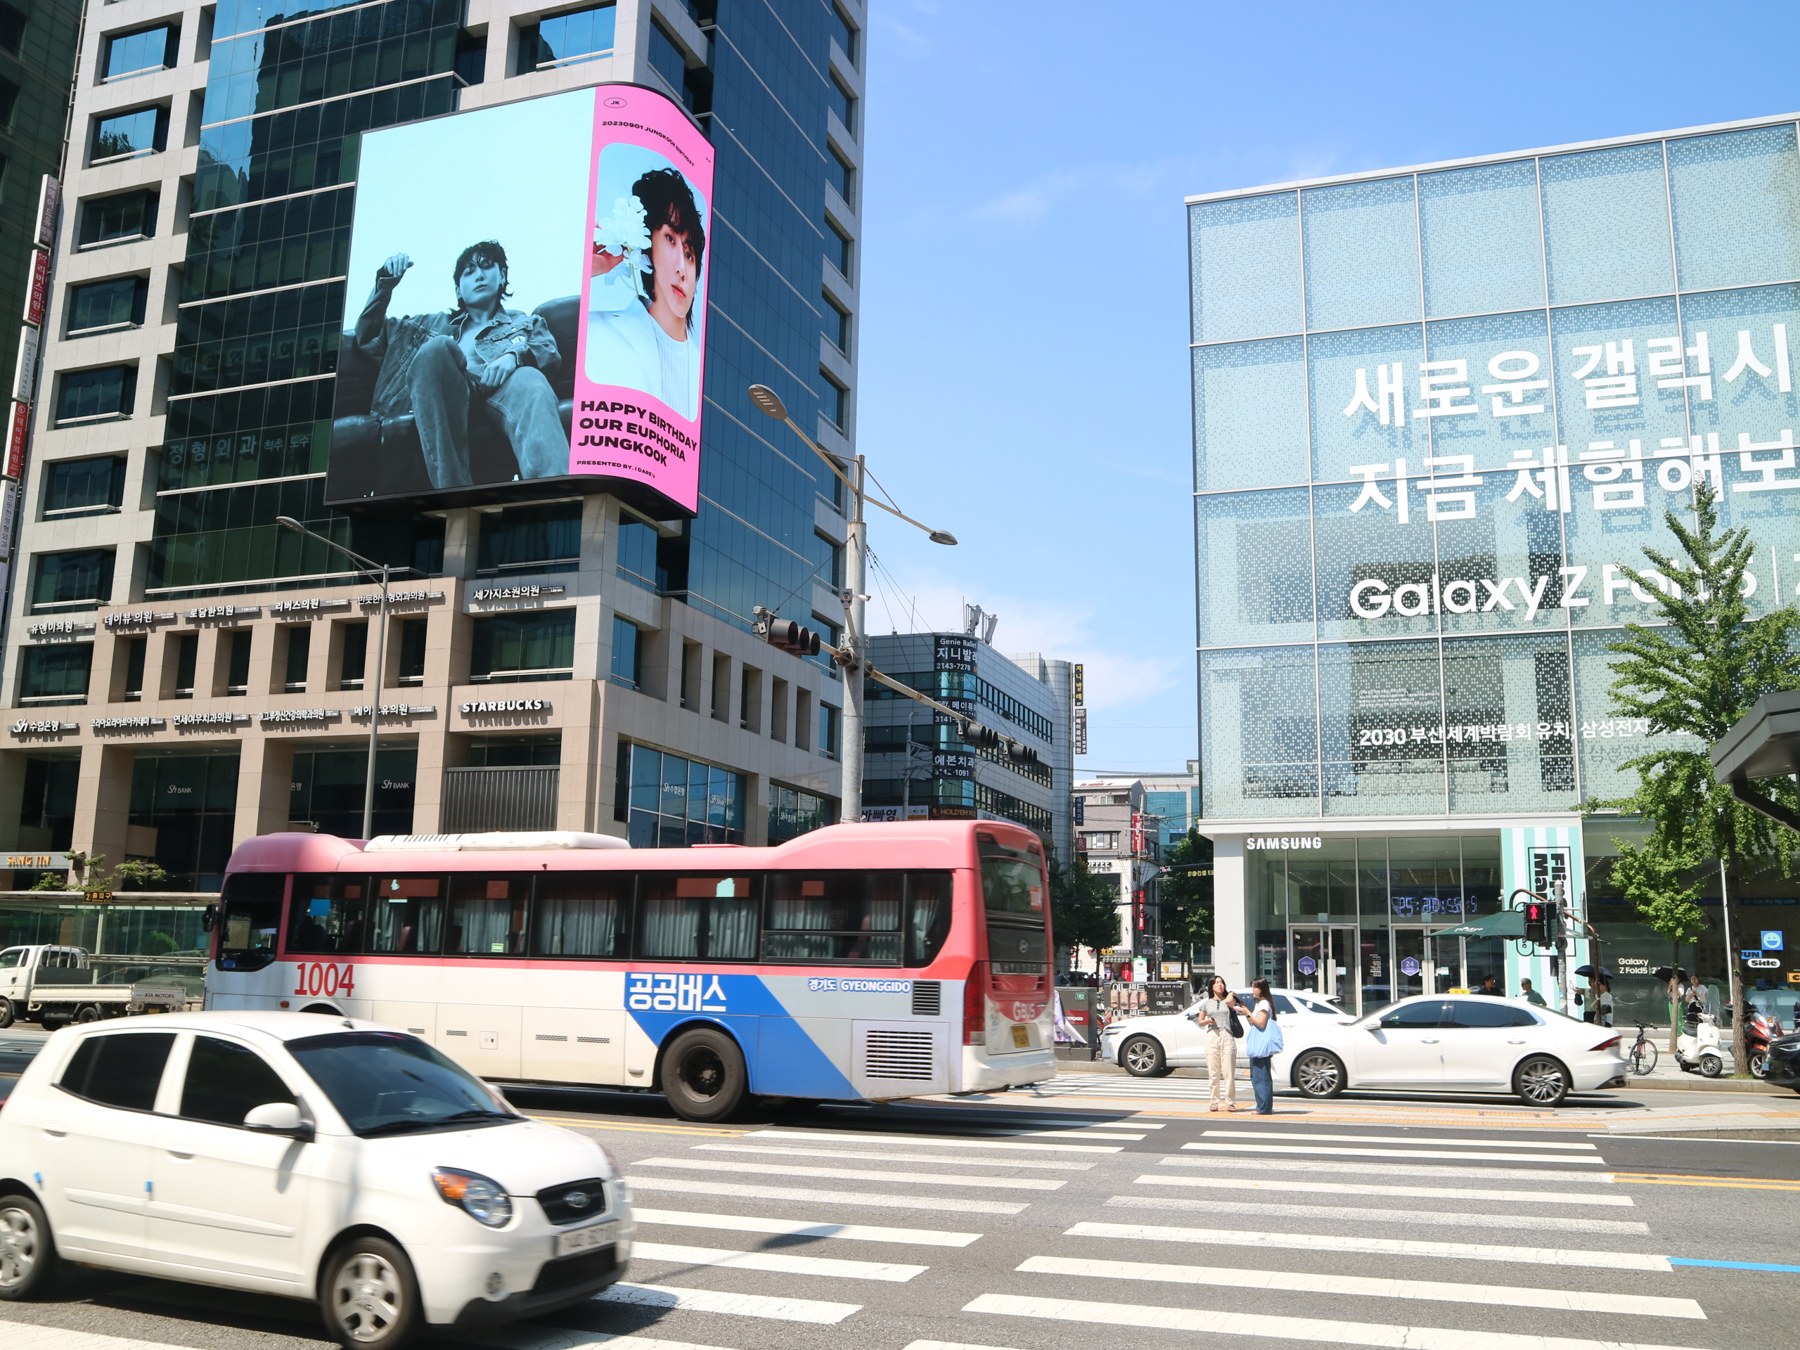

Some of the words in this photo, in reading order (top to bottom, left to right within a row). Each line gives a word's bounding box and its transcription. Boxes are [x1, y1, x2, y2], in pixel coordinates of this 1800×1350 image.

[602, 120, 644, 130] 20230901
[1343, 350, 1549, 427] 새로운
[1571, 323, 1792, 410] 갤럭시
[581, 400, 646, 419] HAPPY
[649, 412, 697, 452] BIRTHDAY
[579, 418, 622, 431] OUR
[626, 422, 686, 462] EUPHORIA
[168, 434, 257, 465] 정형외과
[289, 434, 312, 449] 도수
[578, 435, 667, 467] JUNGKOOK
[577, 460, 622, 468] PRESENTED
[1349, 454, 1484, 525] 지금
[1505, 428, 1800, 513] 체험해보
[357, 590, 426, 605] 반듯한형외과의원
[473, 584, 540, 601] 세가지소원의원
[1351, 573, 1549, 621] Galaxy
[1559, 566, 1590, 607] Z
[189, 604, 235, 618] 로담한의원
[275, 598, 319, 612] 리버스의원
[104, 612, 132, 626] 데이뷰
[133, 610, 153, 624] 의원
[940, 638, 961, 646] Genie
[354, 703, 409, 717] 메이유의원
[462, 699, 543, 713] STARBUCKS
[173, 711, 233, 726] 연세여우치과의원
[1359, 728, 1406, 746] 2030
[1411, 721, 1532, 744] 부산세계박람회
[1535, 719, 1576, 740] 유치,
[167, 784, 177, 794] Sh
[381, 779, 392, 789] Sh
[1247, 836, 1322, 850] SAMSUNG
[1405, 960, 1415, 968] 24
[1618, 957, 1649, 967] Galaxy
[1751, 959, 1778, 967] Side
[1619, 966, 1625, 974] Z
[1625, 966, 1648, 974] Fold5
[294, 962, 355, 998] 1004
[808, 978, 837, 991] 경기도
[840, 980, 911, 992] GYEONGGIDO
[629, 973, 727, 1012] 공공버스
